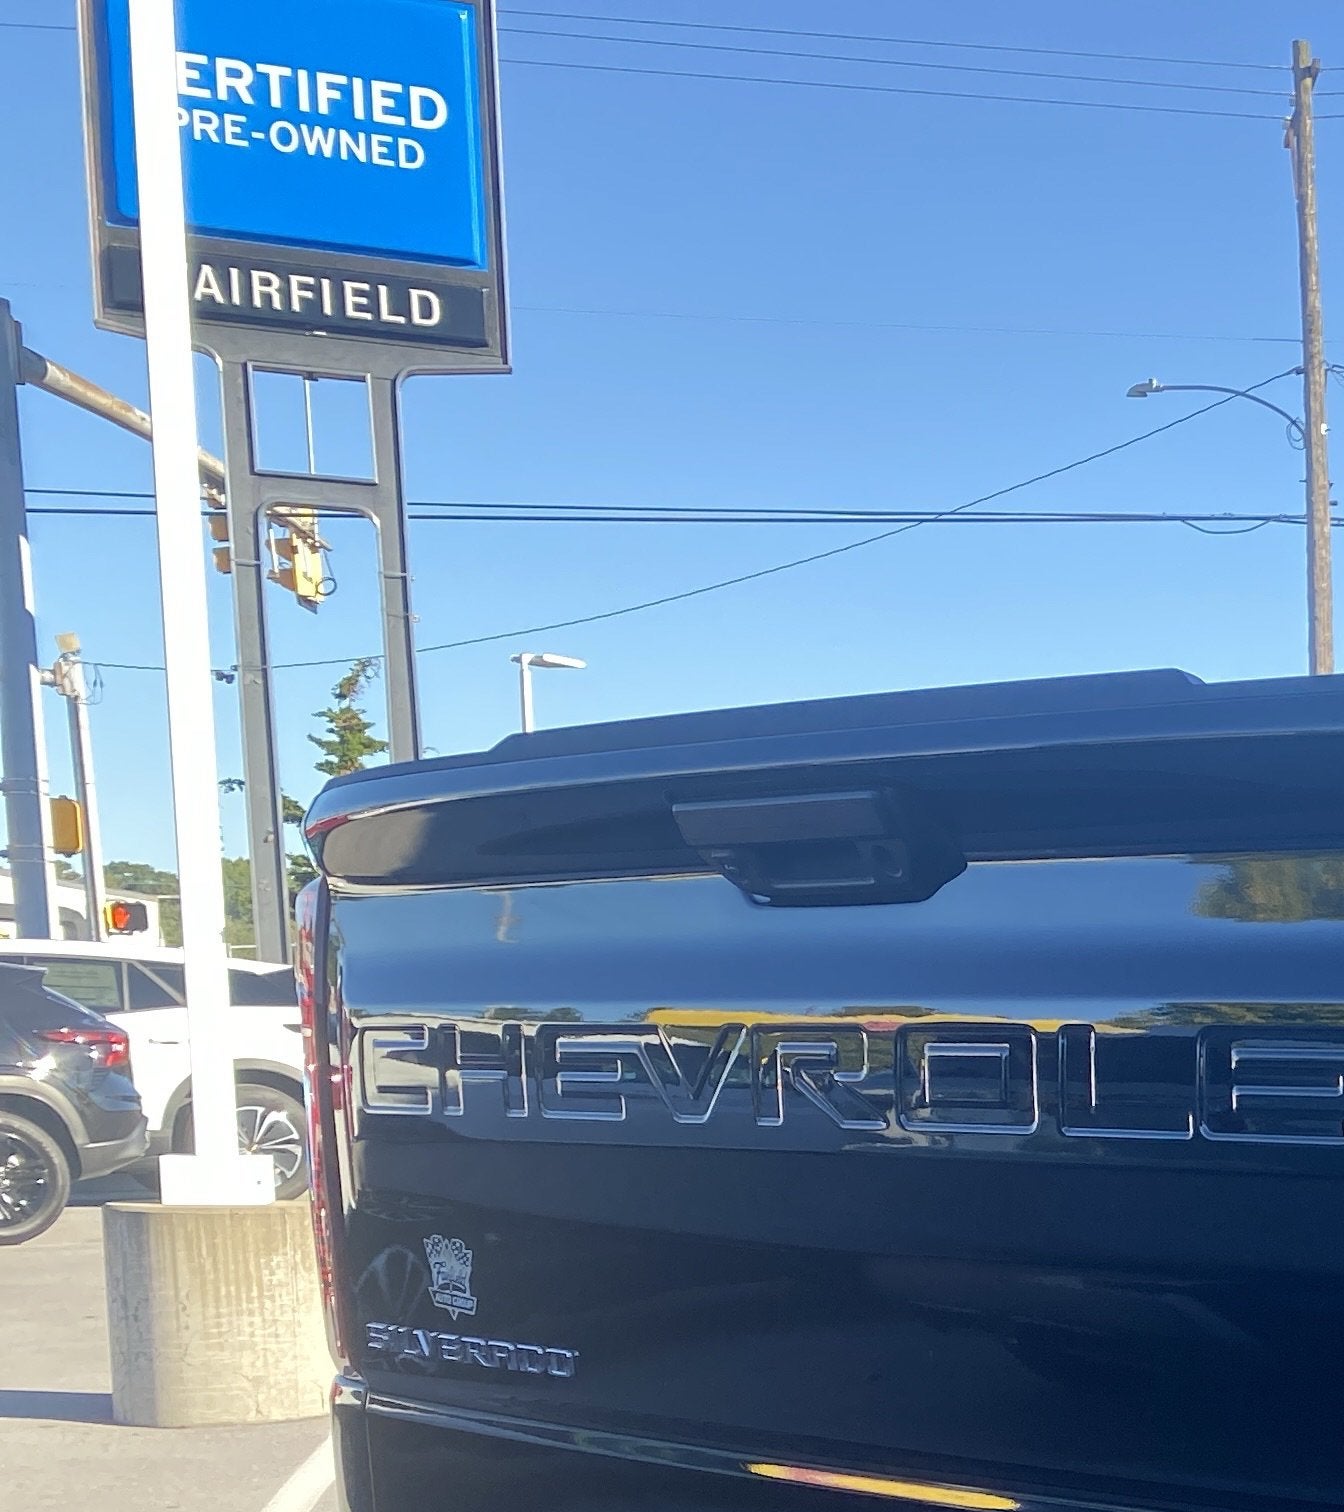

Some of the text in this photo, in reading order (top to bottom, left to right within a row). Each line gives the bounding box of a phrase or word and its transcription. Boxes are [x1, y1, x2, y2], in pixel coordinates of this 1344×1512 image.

[176, 50, 448, 130] ERTIFIED
[194, 262, 442, 327] AIRFIELD
[366, 1321, 580, 1378] SILVERADO
